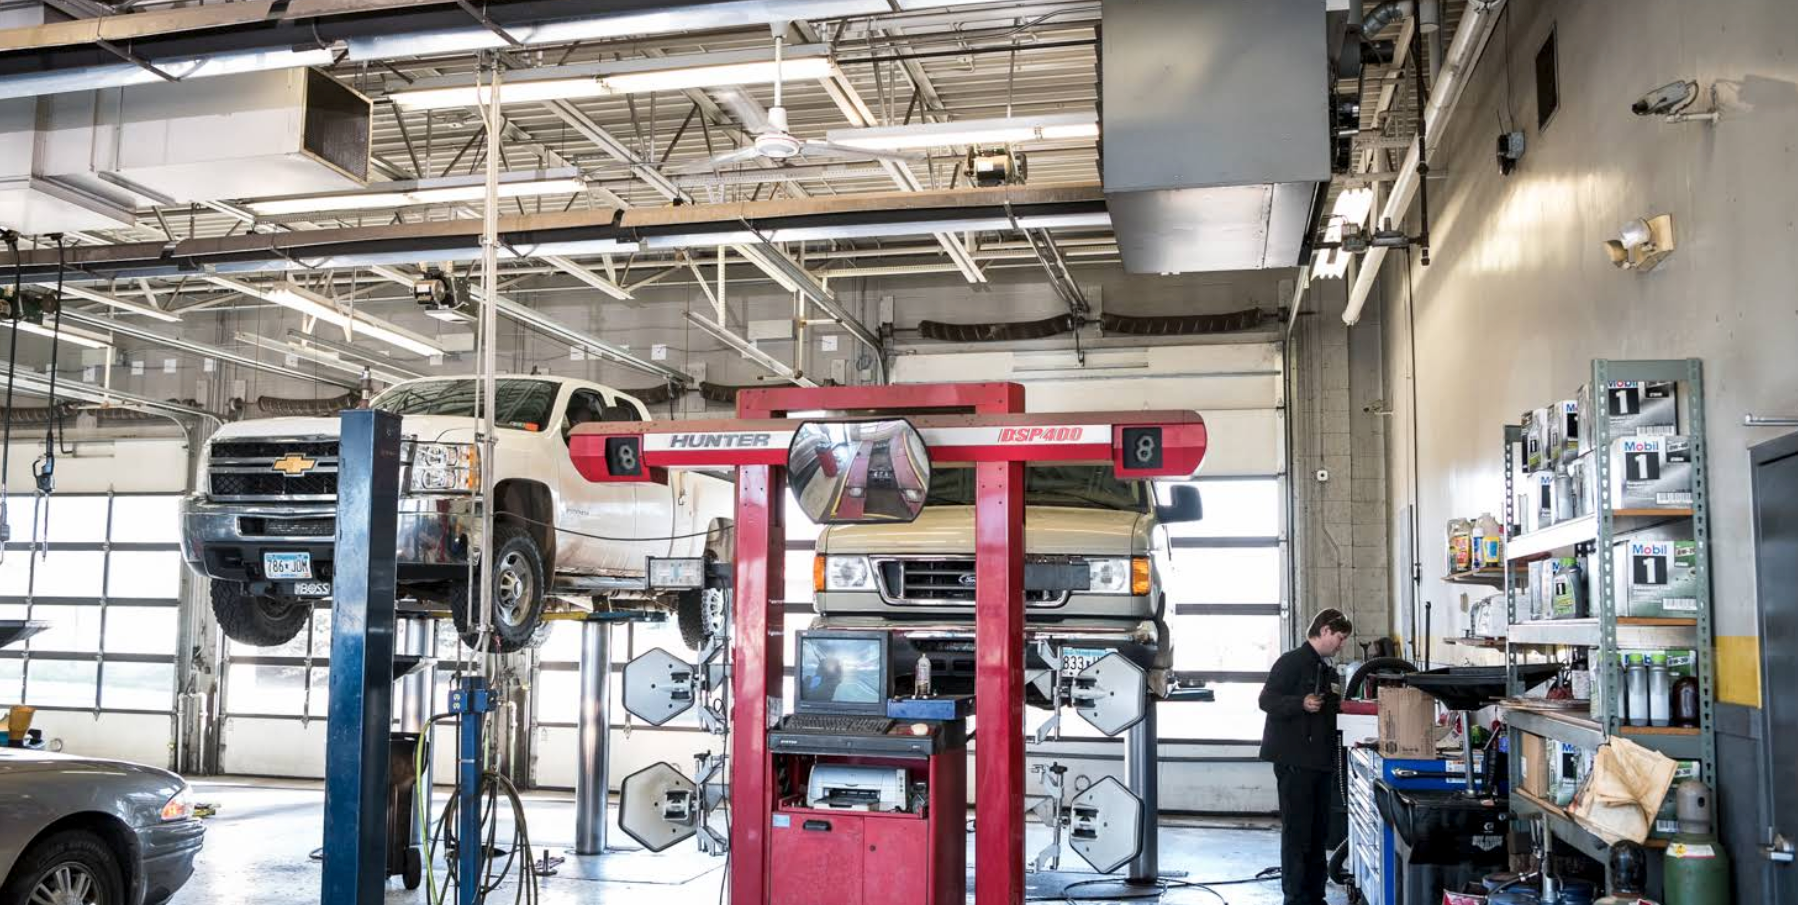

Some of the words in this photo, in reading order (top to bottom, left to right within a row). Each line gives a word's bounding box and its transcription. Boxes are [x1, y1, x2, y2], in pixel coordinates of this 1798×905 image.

[1615, 390, 1628, 414] 1
[670, 433, 771, 448] HUNTER
[998, 427, 1083, 443] DSP400
[1624, 441, 1659, 451] Mobil
[1634, 454, 1648, 479] 1
[1632, 544, 1667, 555] Mobil
[267, 560, 284, 573] 786
[1643, 557, 1656, 583] 1
[301, 583, 329, 595] BOSS
